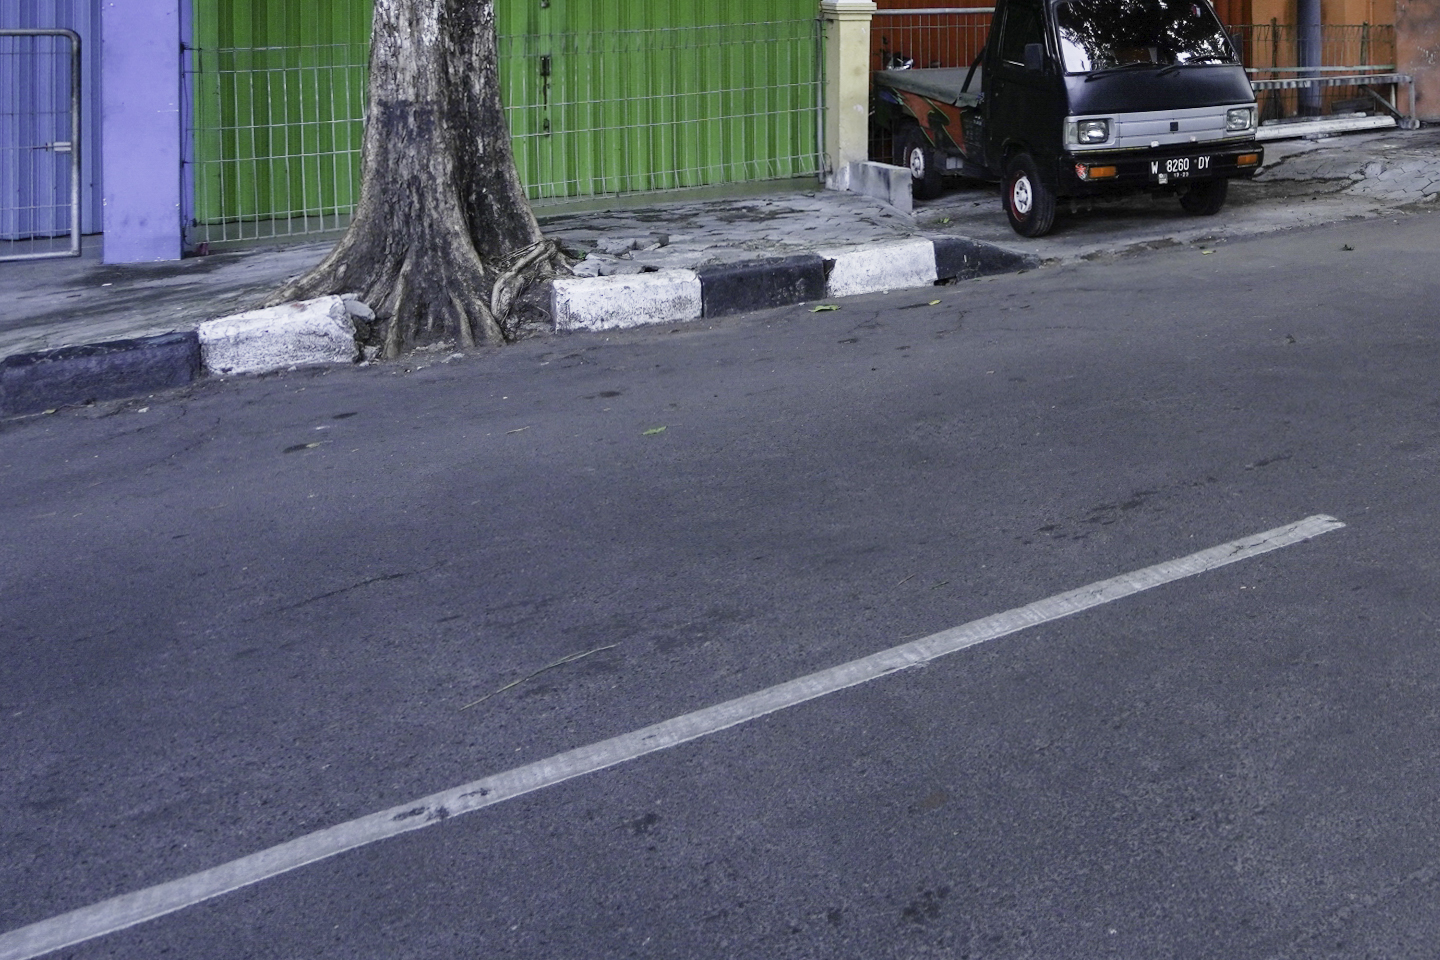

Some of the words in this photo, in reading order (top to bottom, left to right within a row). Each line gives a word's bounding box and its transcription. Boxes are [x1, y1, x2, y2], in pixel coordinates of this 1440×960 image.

[1151, 161, 1159, 174] W
[1166, 157, 1190, 172] 8260
[1198, 156, 1210, 169] DY
